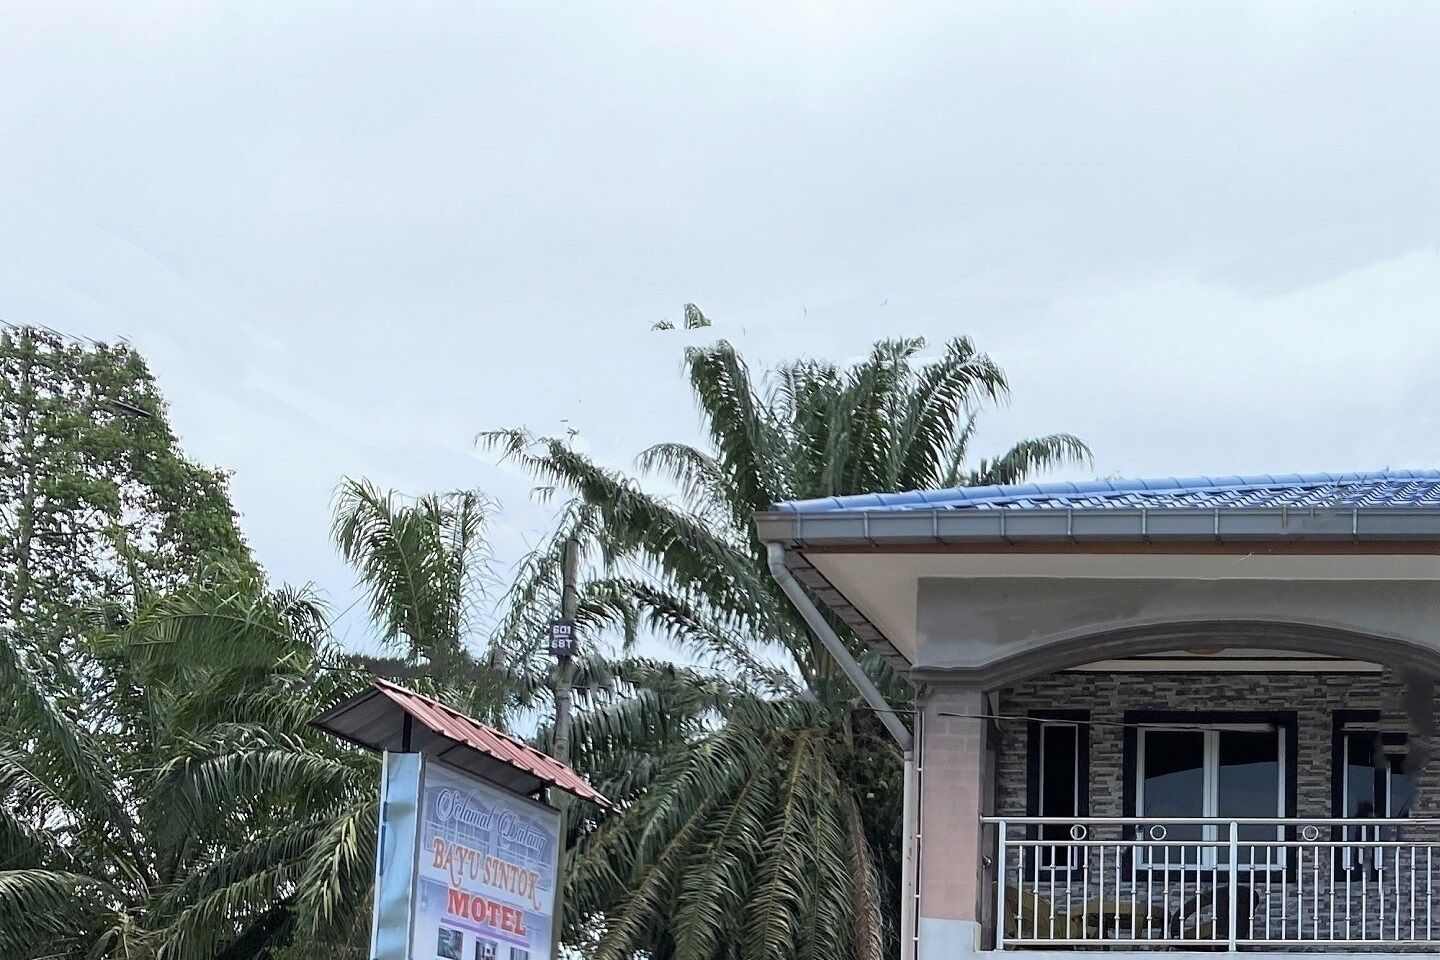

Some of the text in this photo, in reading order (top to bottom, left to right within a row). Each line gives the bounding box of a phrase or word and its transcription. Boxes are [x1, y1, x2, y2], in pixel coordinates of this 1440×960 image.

[432, 836, 541, 911] BAYU SINTOK
[447, 887, 527, 936] MOTEL
